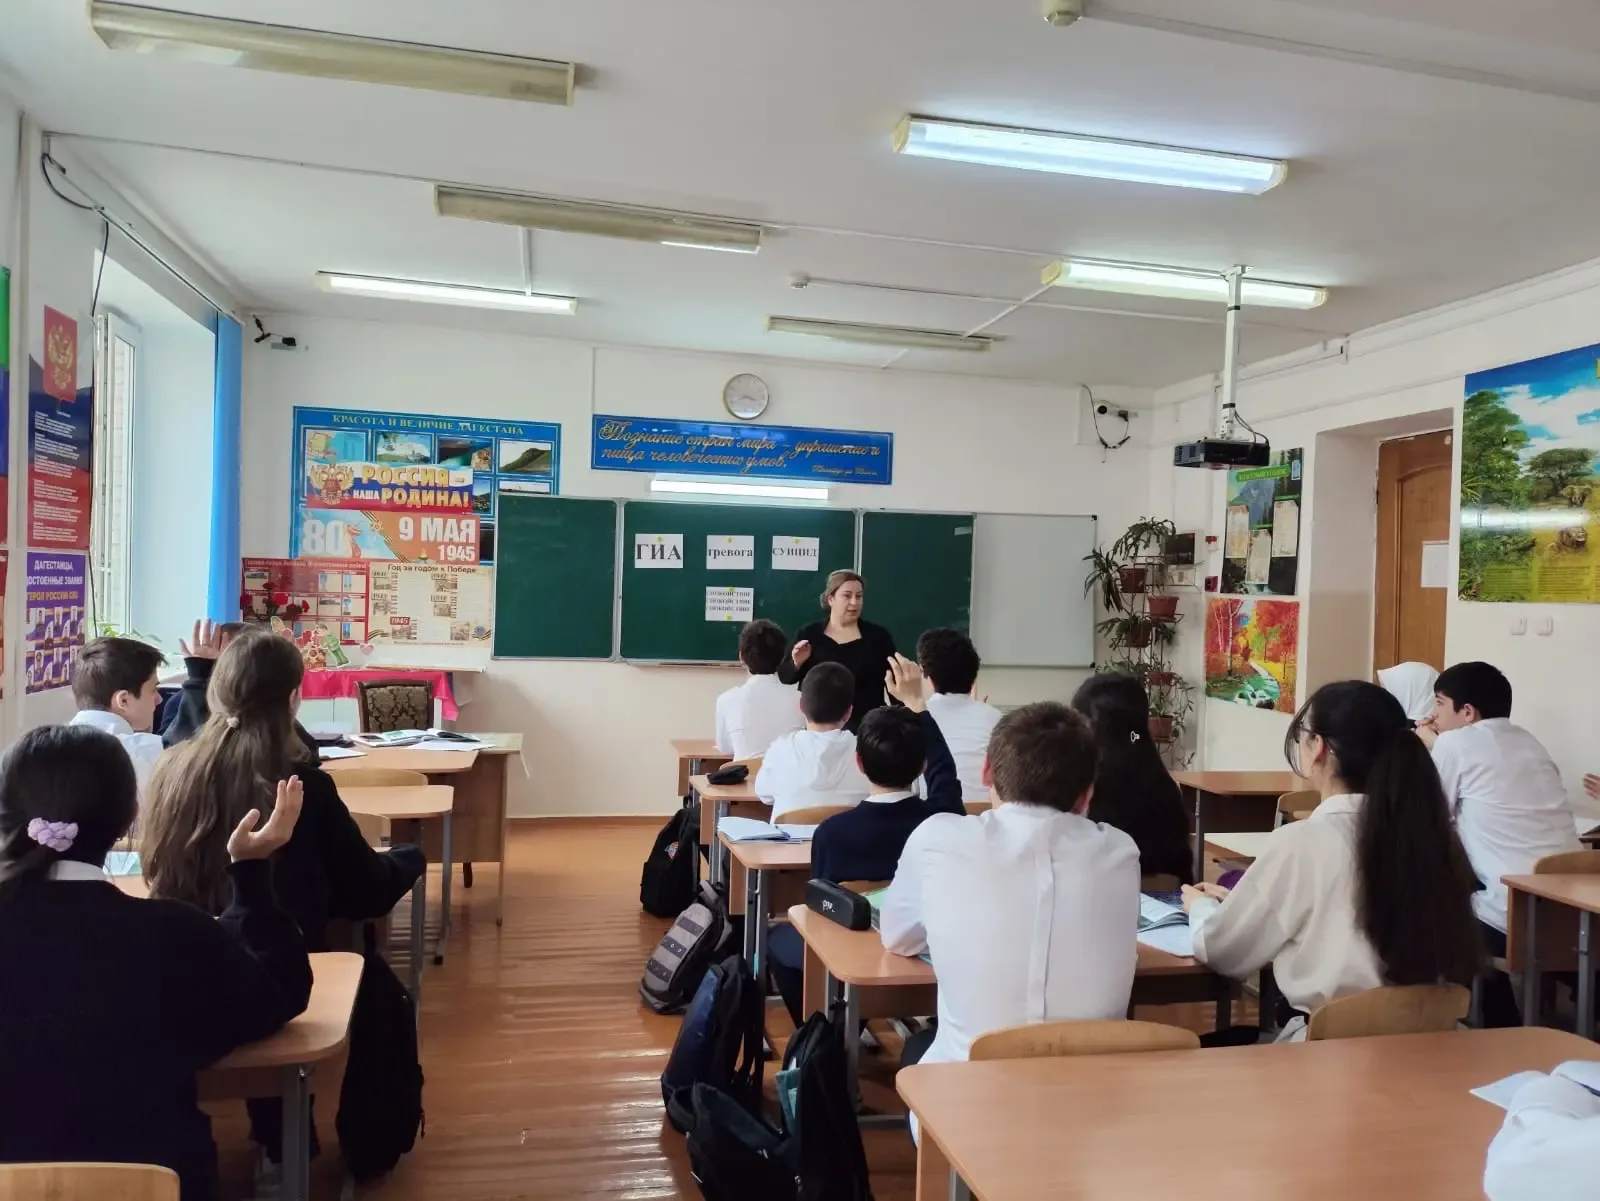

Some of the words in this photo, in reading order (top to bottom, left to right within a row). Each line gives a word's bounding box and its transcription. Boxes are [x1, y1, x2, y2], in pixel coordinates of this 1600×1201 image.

[332, 414, 386, 426] КРАСОТА
[388, 416, 397, 427] И
[456, 422, 524, 435] ДАГЕСТАНА
[598, 419, 684, 450] Познание
[361, 464, 449, 488] РОССИЯ
[352, 489, 380, 501] НАША
[381, 487, 470, 509] РОДИНА!
[302, 519, 345, 556] 80
[398, 516, 414, 541] 9
[420, 517, 476, 543] МАЯ
[438, 544, 476, 562] 1945
[636, 543, 682, 560] ГИА
[707, 548, 753, 560] тревога
[387, 563, 402, 572] Год
[447, 565, 477, 574] Победе
[391, 616, 409, 625] 1945
